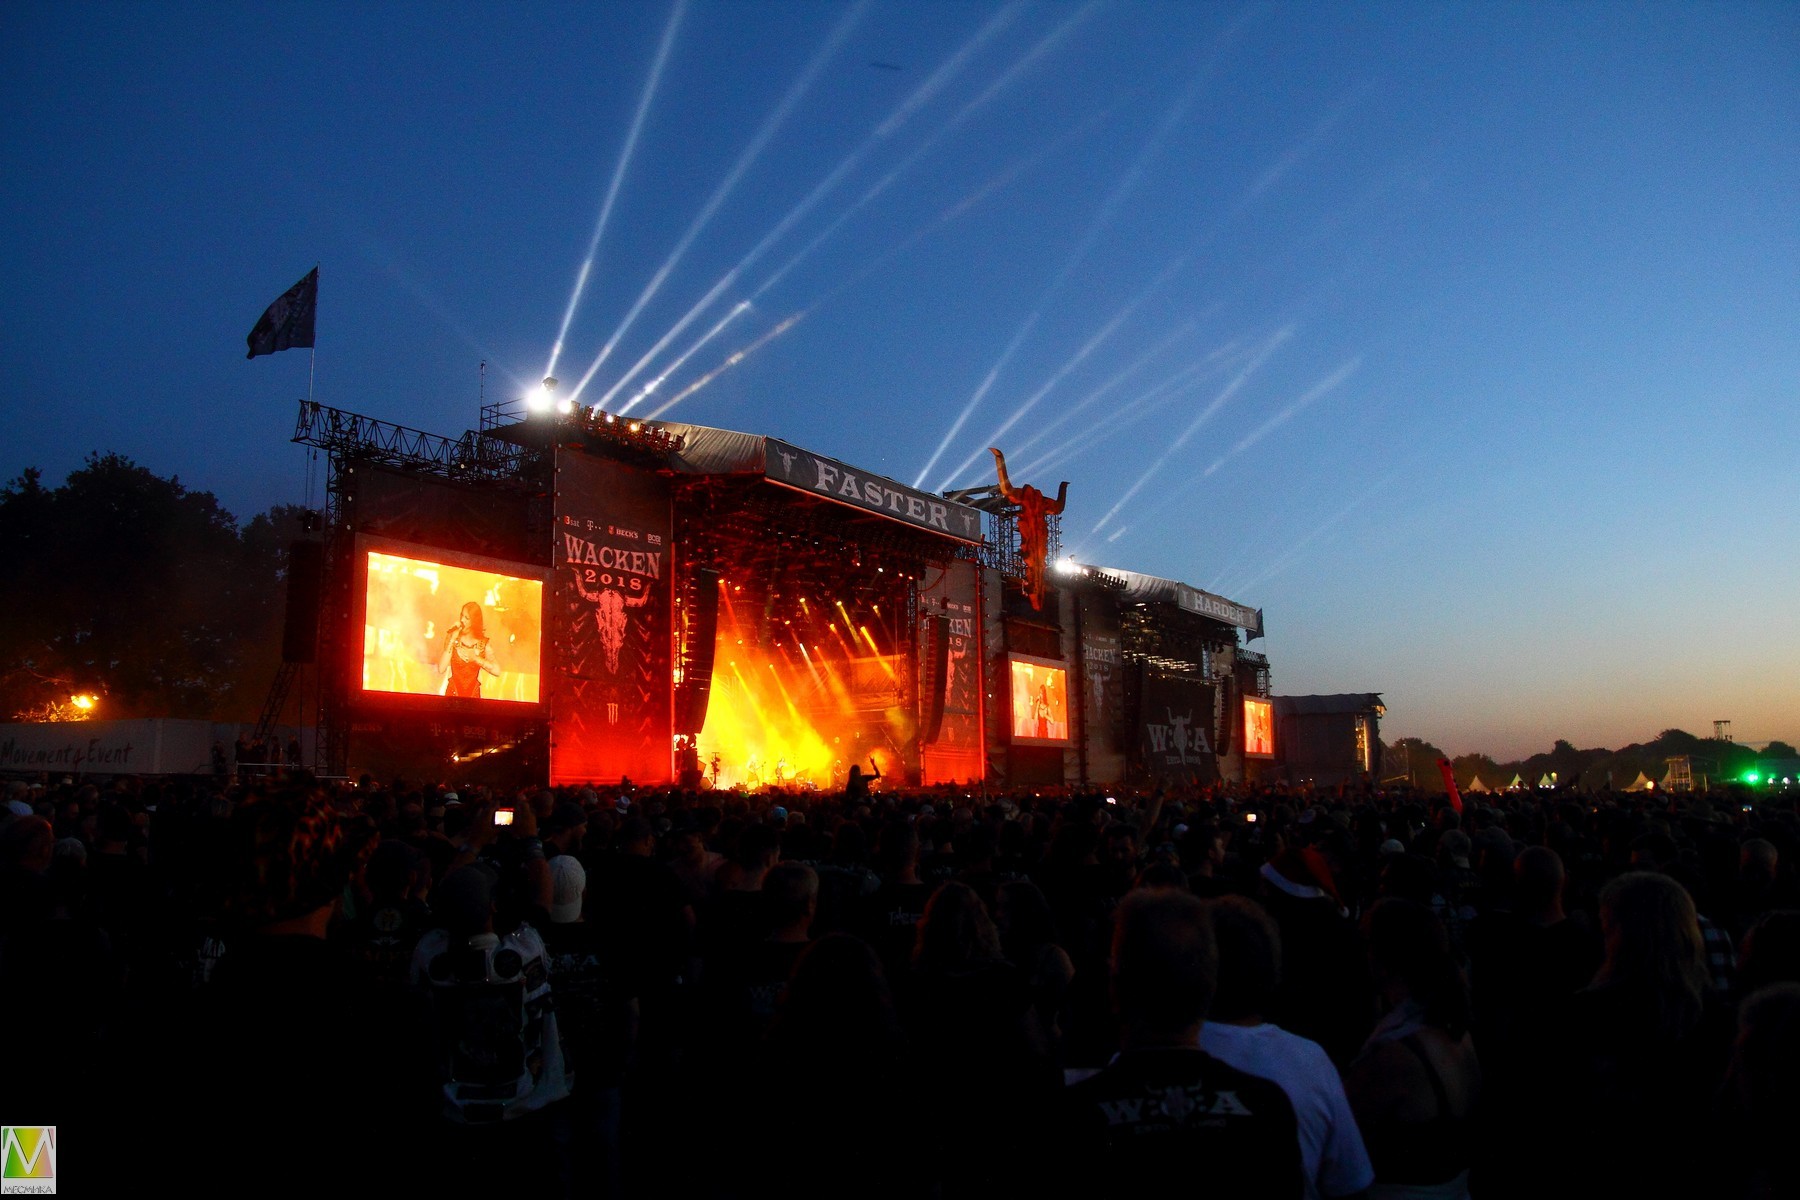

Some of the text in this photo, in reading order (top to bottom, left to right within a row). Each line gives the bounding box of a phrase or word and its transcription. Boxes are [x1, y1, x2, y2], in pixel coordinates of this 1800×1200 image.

[814, 458, 949, 531] FASTER
[564, 532, 661, 580] WACKEN
[585, 569, 642, 590] 2018
[1193, 591, 1245, 625] HARDER
[1, 738, 72, 764] Movement
[88, 738, 133, 764] Event
